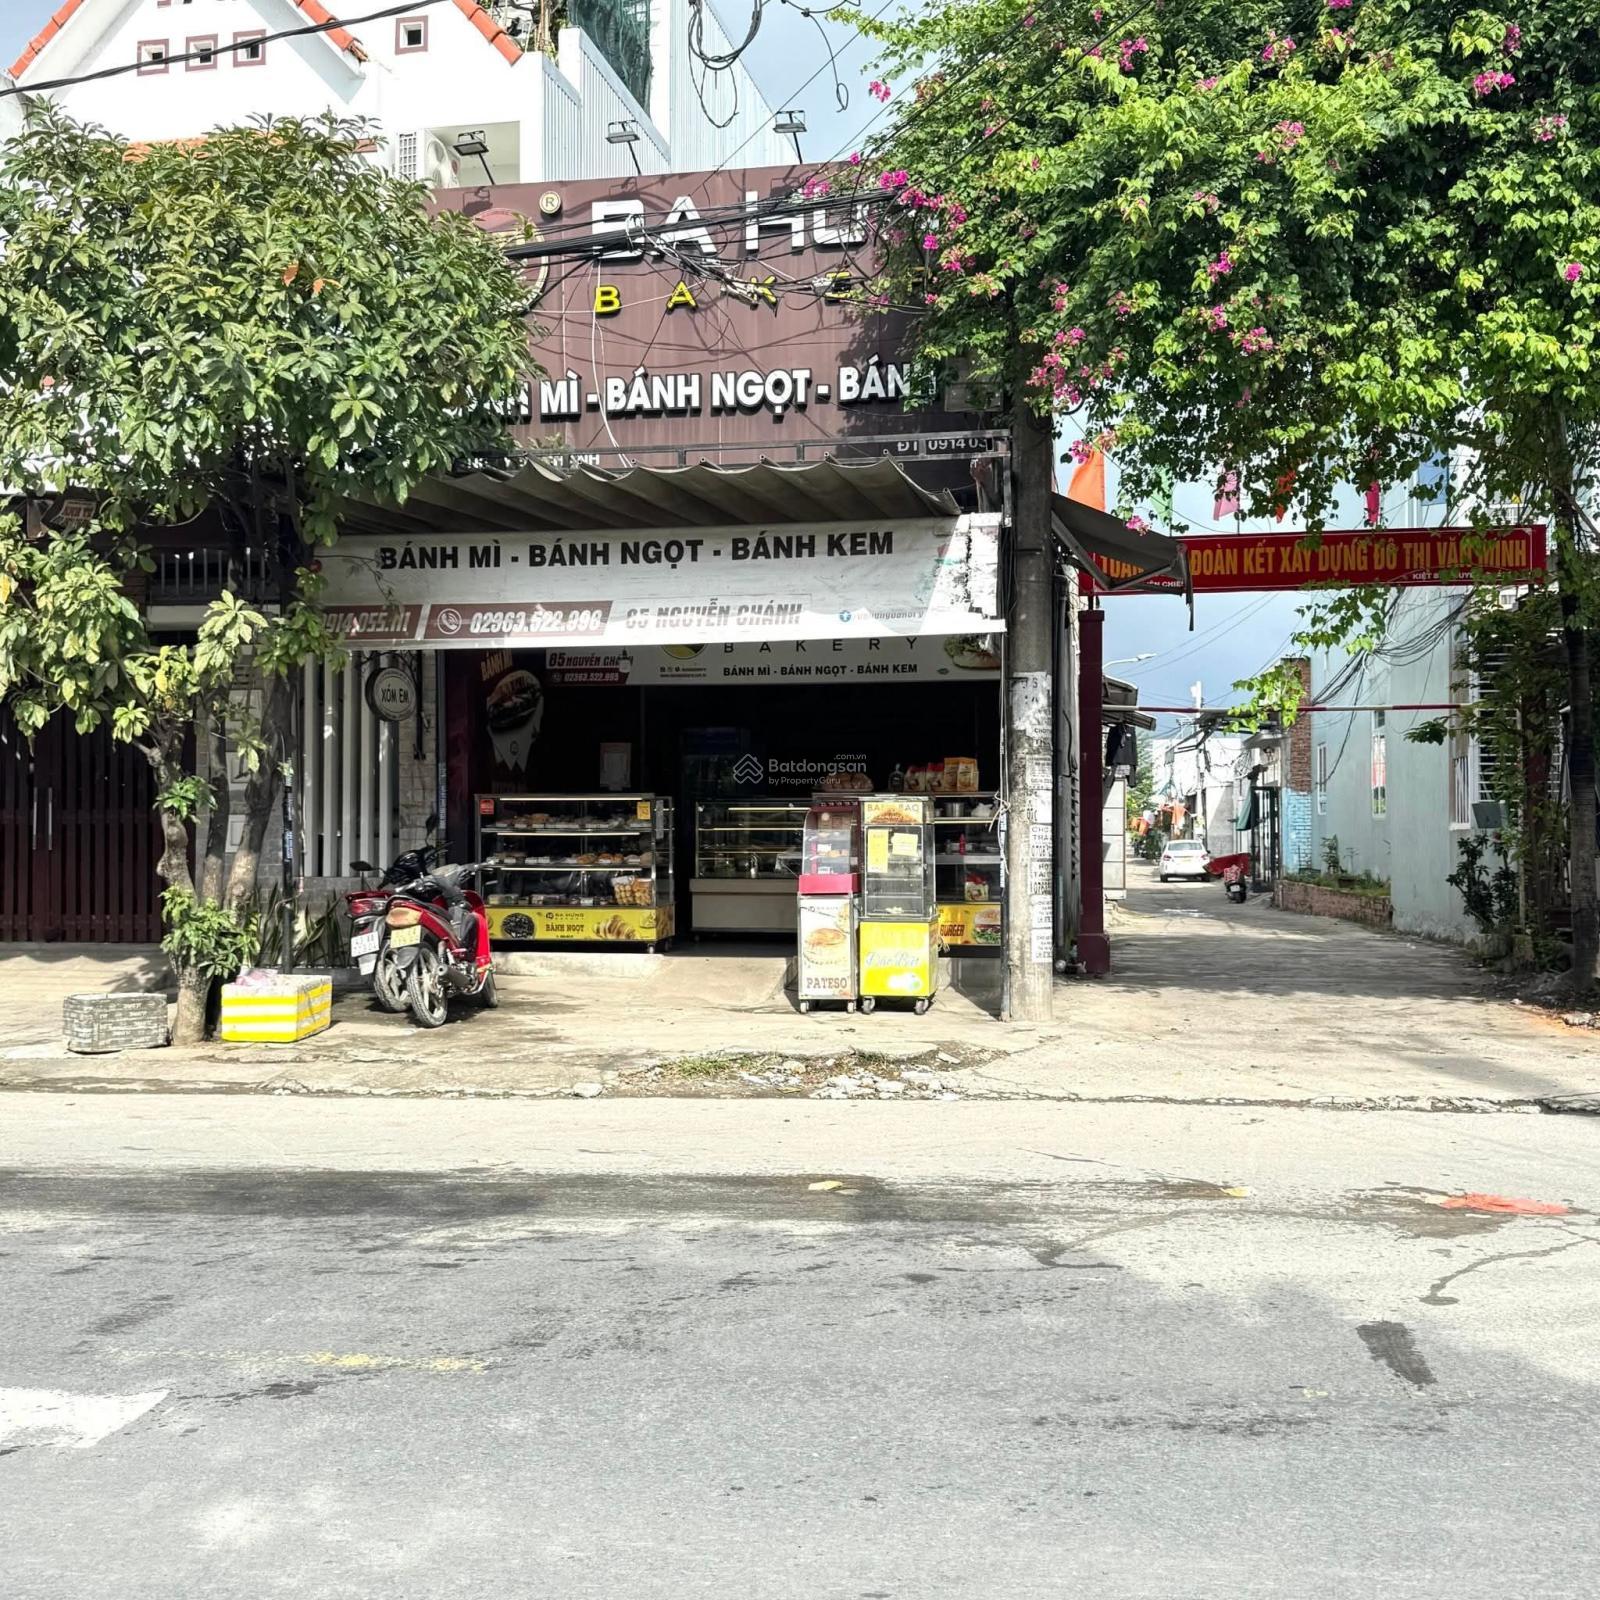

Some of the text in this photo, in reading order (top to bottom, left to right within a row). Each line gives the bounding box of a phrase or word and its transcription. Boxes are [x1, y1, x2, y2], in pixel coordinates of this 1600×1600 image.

[540, 368, 579, 414] MÌ
[606, 366, 700, 411] BÁNH
[711, 368, 811, 414] NGỌT
[379, 541, 459, 569] BÁNH
[469, 539, 501, 569] MÌ
[528, 538, 610, 567] BÁNH
[621, 539, 704, 569] NGỌT
[731, 530, 816, 561] BÁNH
[827, 531, 894, 557] KEM
[1190, 544, 1238, 576] ĐOÀN
[1243, 539, 1276, 575] KẾT
[1318, 536, 1369, 577] DỰNG
[1402, 541, 1431, 573] THỊ
[737, 599, 803, 626] CHÁNH
[723, 663, 755, 676] BÁNH
[757, 664, 771, 676] MÌ
[780, 663, 813, 676] BÁNH
[815, 664, 848, 678] NGỌT
[857, 662, 889, 675] BÁNH
[892, 663, 918, 674] KEM
[380, 682, 410, 704] XÓM EM
